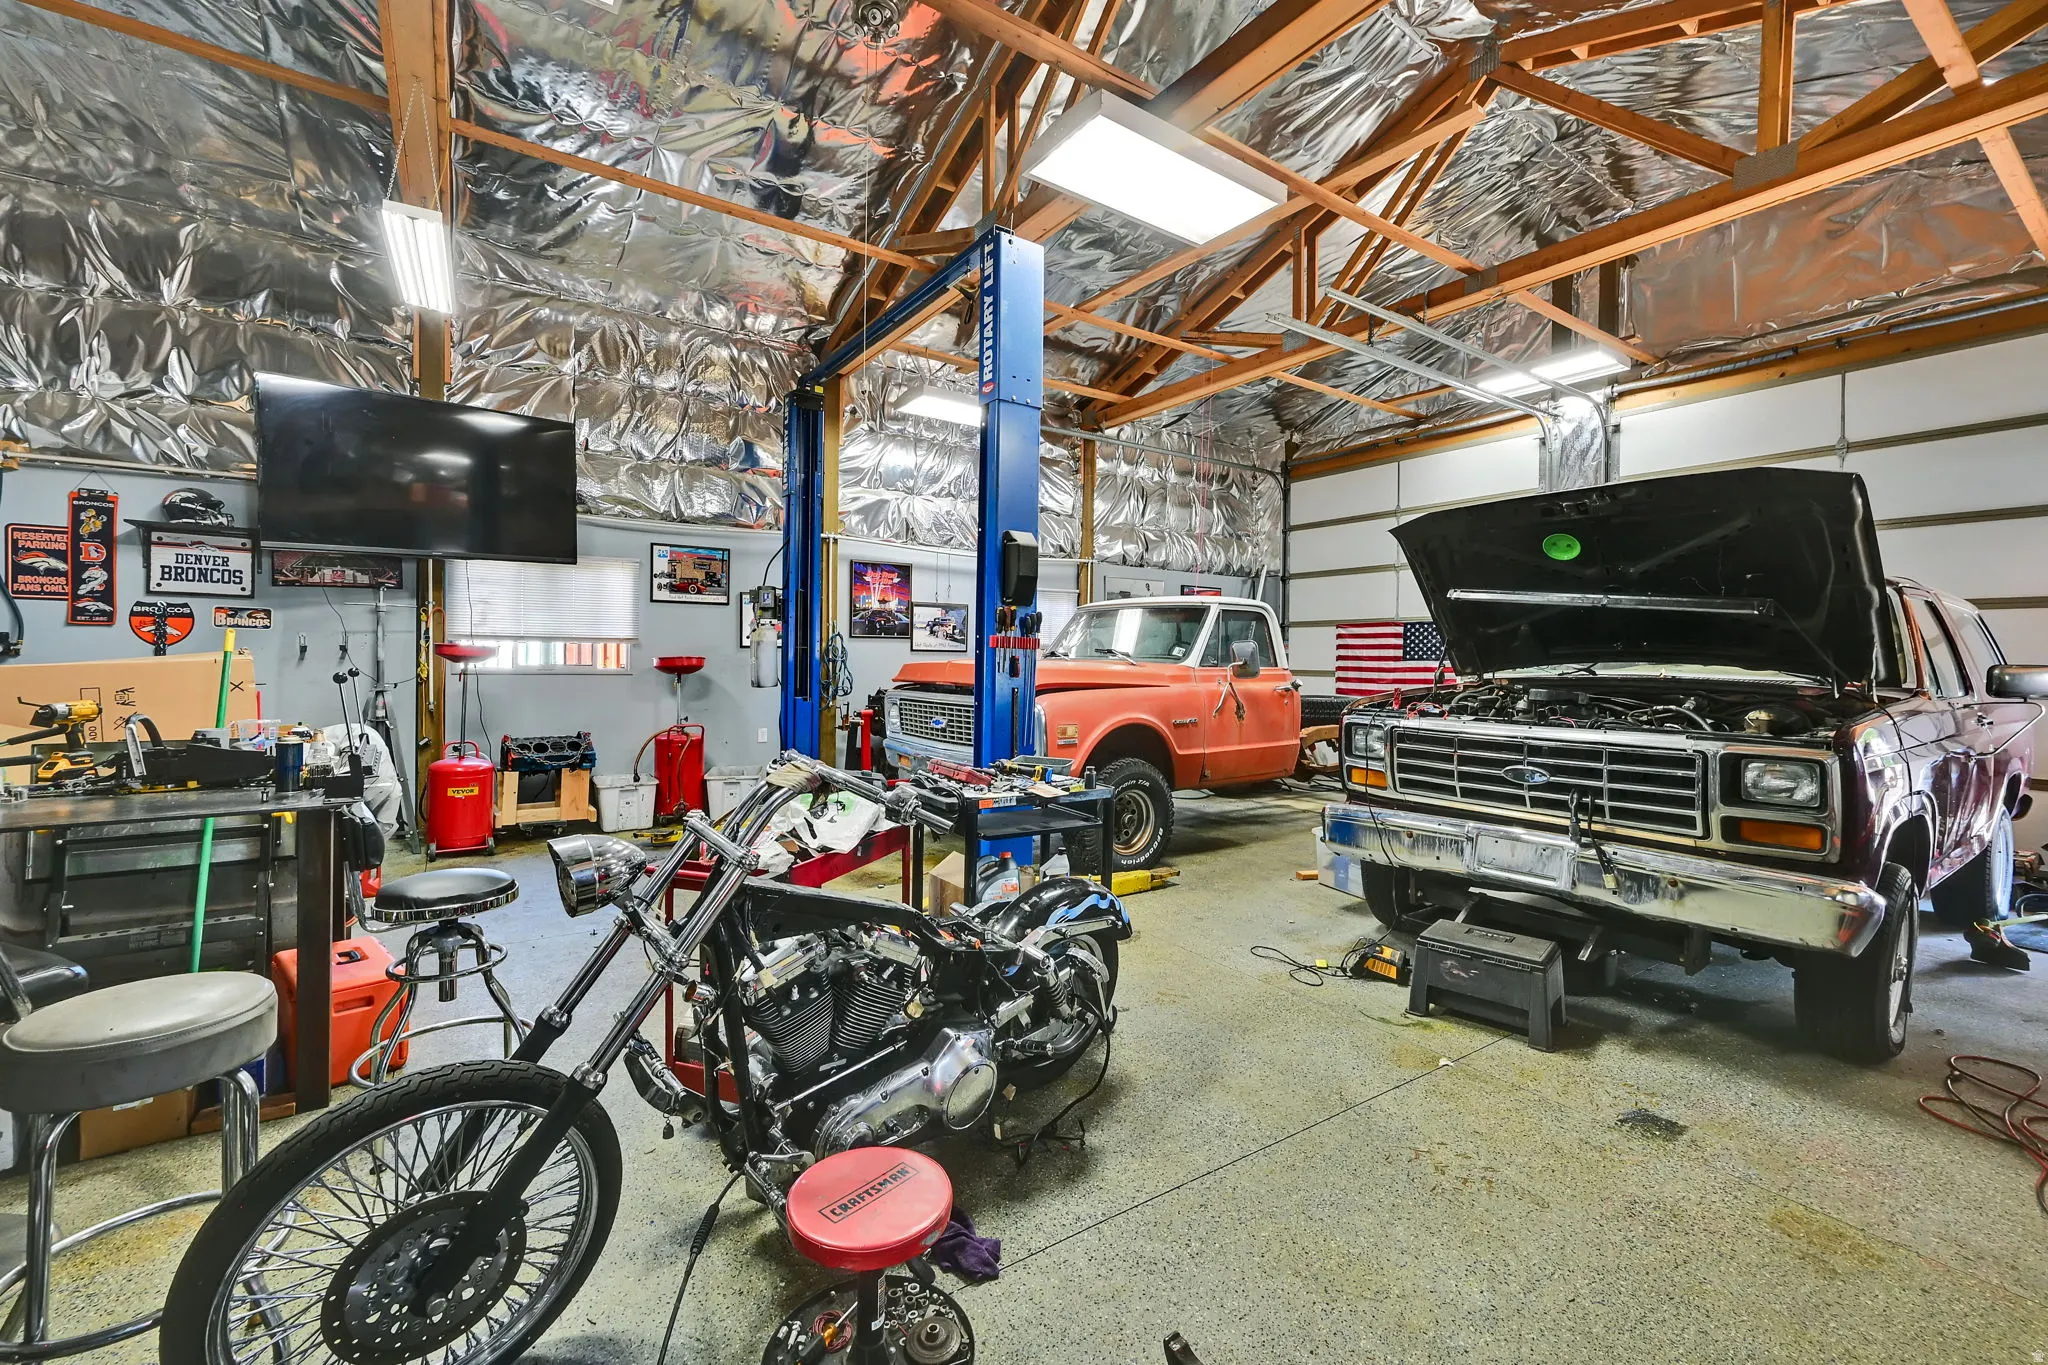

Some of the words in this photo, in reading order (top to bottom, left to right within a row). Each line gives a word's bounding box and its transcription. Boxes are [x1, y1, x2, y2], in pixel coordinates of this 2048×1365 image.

[984, 242, 994, 289] LIFT
[983, 295, 994, 382] ROTARY
[72, 500, 114, 508] BRONCOS
[18, 540, 66, 550] PARKING
[174, 553, 230, 567] DENVER
[17, 575, 66, 585] BRONCOS
[159, 565, 244, 585] BRONCOS
[13, 583, 41, 591] FANS
[133, 605, 191, 614] BROCOS
[215, 611, 270, 626] BRONCOS
[1115, 780, 1136, 794] rrain
[829, 1167, 910, 1217] CRAFTSMAN
